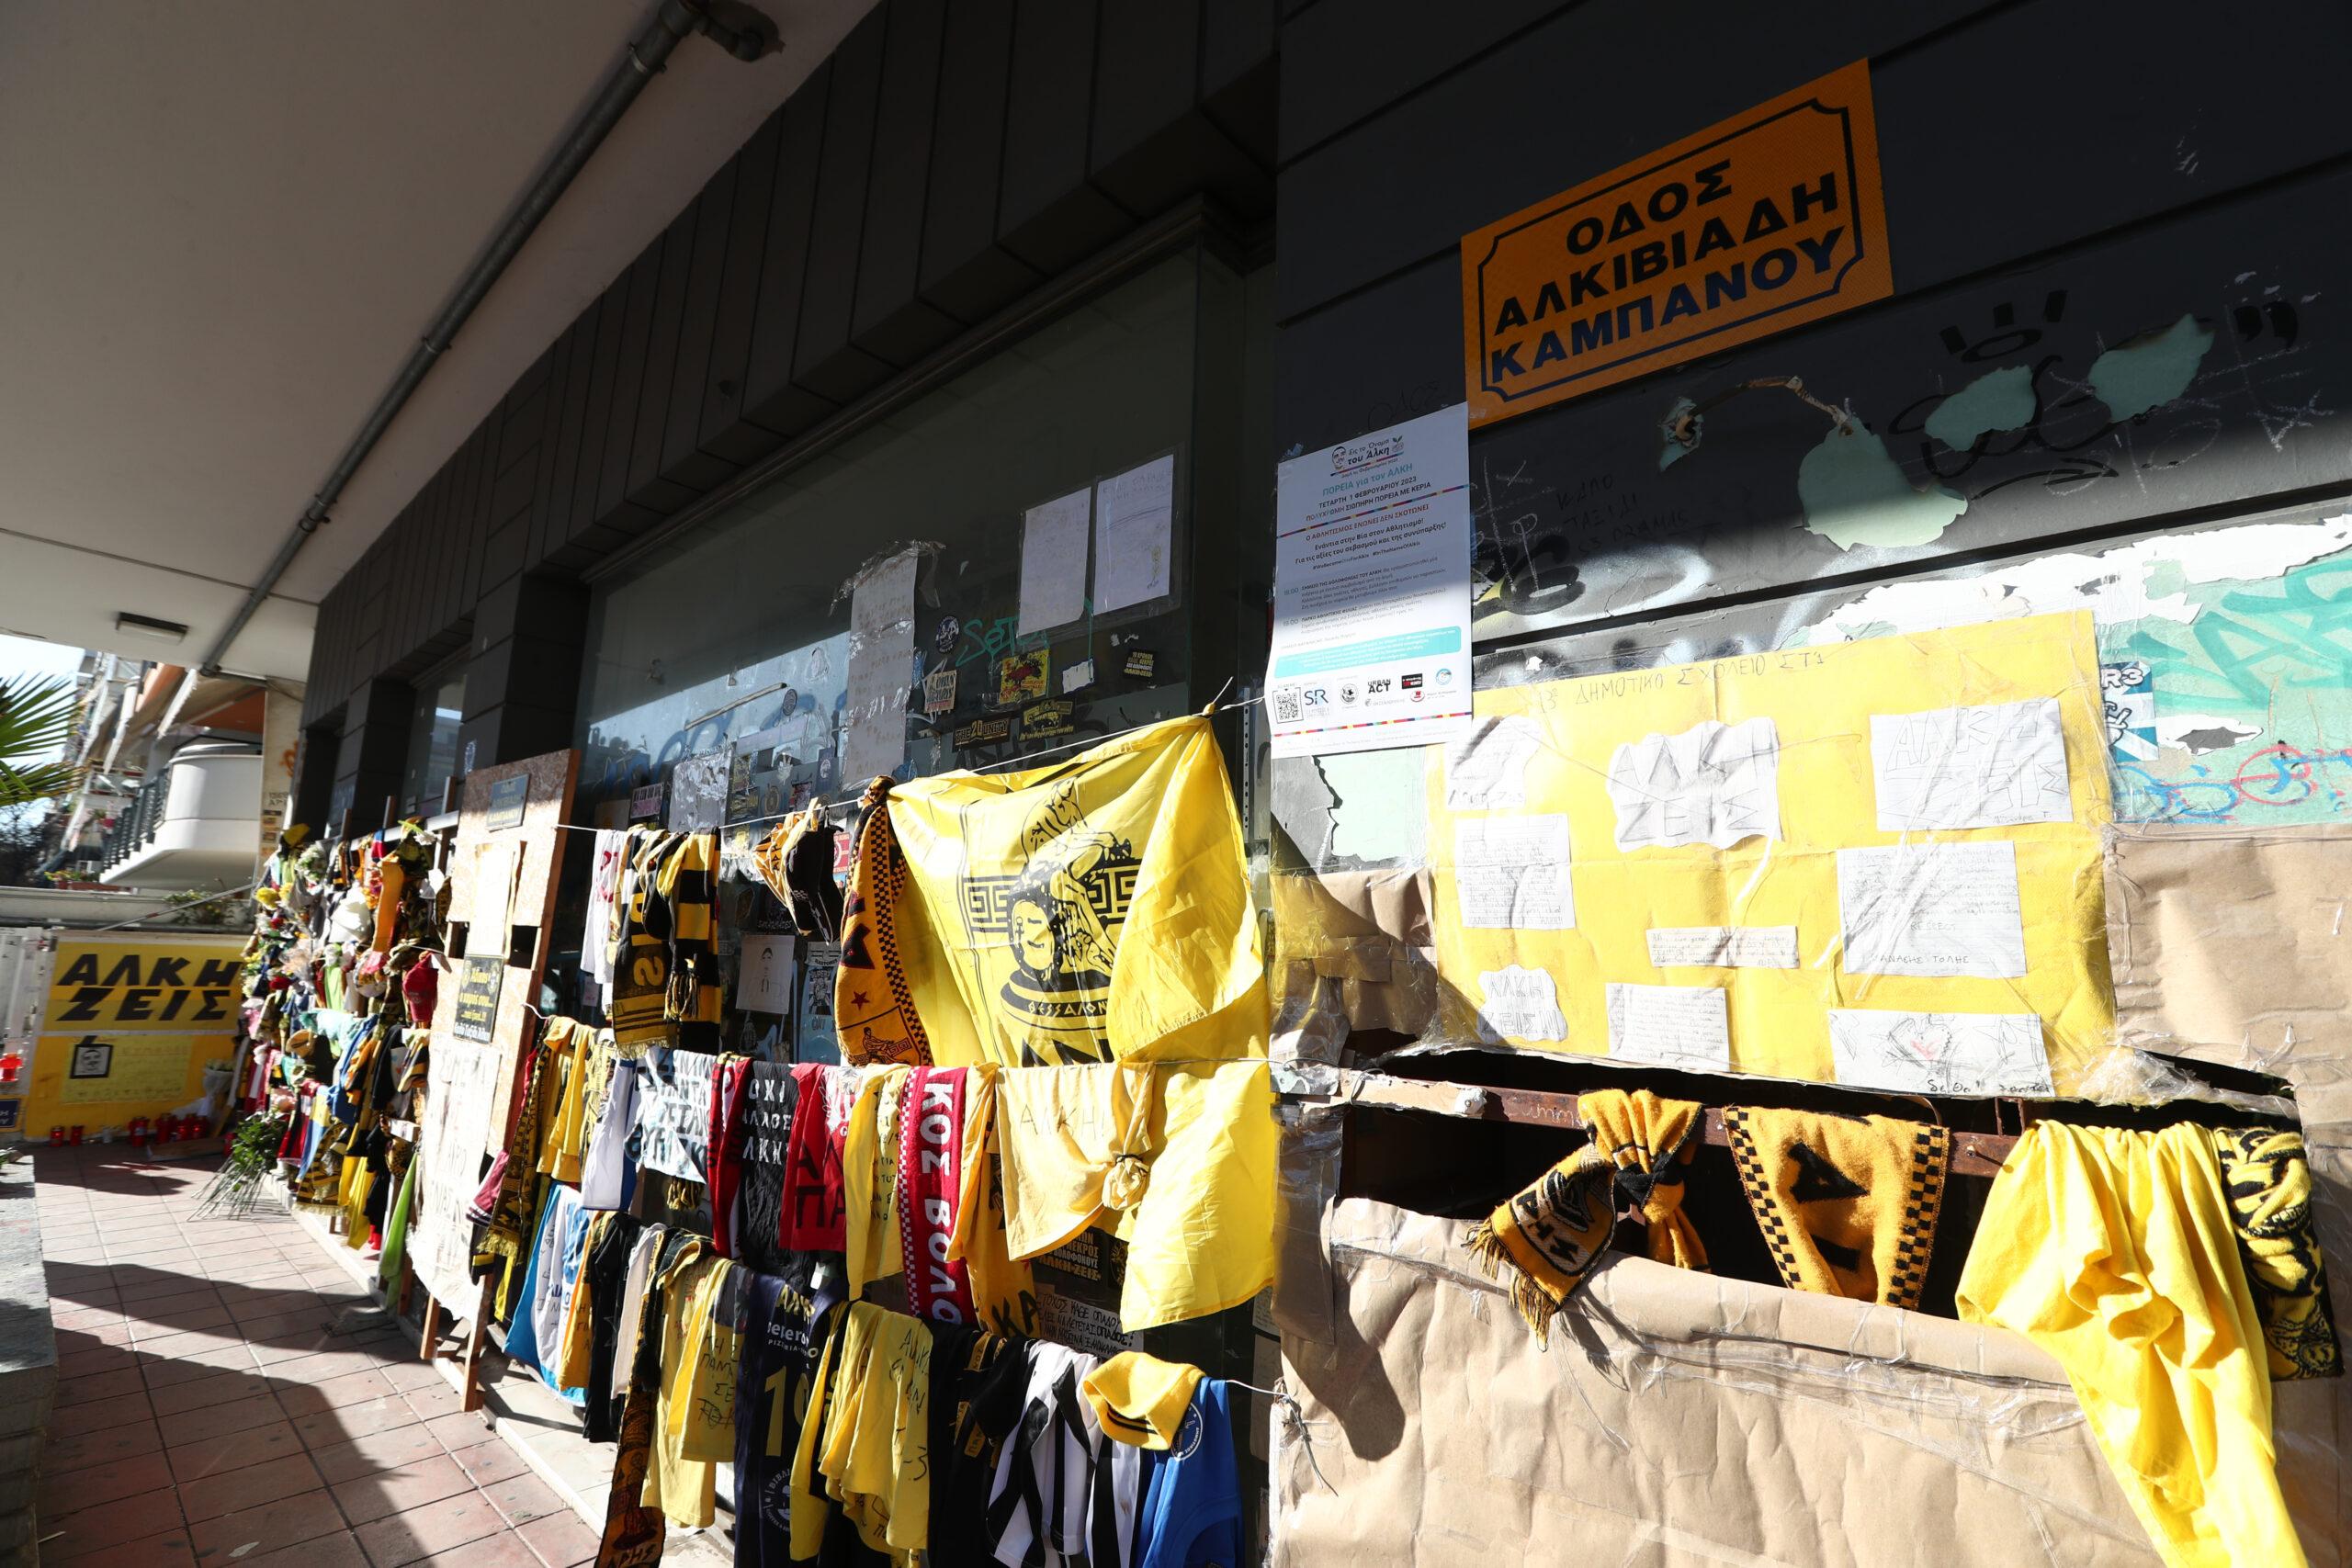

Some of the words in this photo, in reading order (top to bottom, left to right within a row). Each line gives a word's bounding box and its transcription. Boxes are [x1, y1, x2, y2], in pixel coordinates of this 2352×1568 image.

[1566, 159, 1732, 255] ΟΔΟΣ
[1494, 172, 1838, 336] ΑΛΚΙΒΙΑΔΗ
[1491, 226, 1845, 383] ΚΑΜΠΑΝΟΥ
[1348, 455, 1363, 466] του
[1319, 496, 1347, 509] ΤΕΤΑΡΤΗ
[1354, 481, 1400, 499] ΦΕΒΡΟΥΑΡΙΟΥ
[1401, 476, 1417, 486] 2023
[1323, 481, 1354, 497] ΠΟΡΕΙΑ
[1372, 473, 1385, 482] τον
[1387, 463, 1413, 478] ΑΛΚΗ
[1369, 683, 1390, 694] ACT
[1575, 677, 1663, 705] ΔΗΜΟΤΙΚΟ
[1677, 655, 1766, 686] ΣΧΟΛΕΙΟ
[57, 953, 243, 987] ΑΛΚΗ
[56, 987, 231, 1021] ΖΕΙΣ
[748, 1078, 786, 1103] ΟΧΙ
[923, 1197, 963, 1325] ΒΟΛΟ
